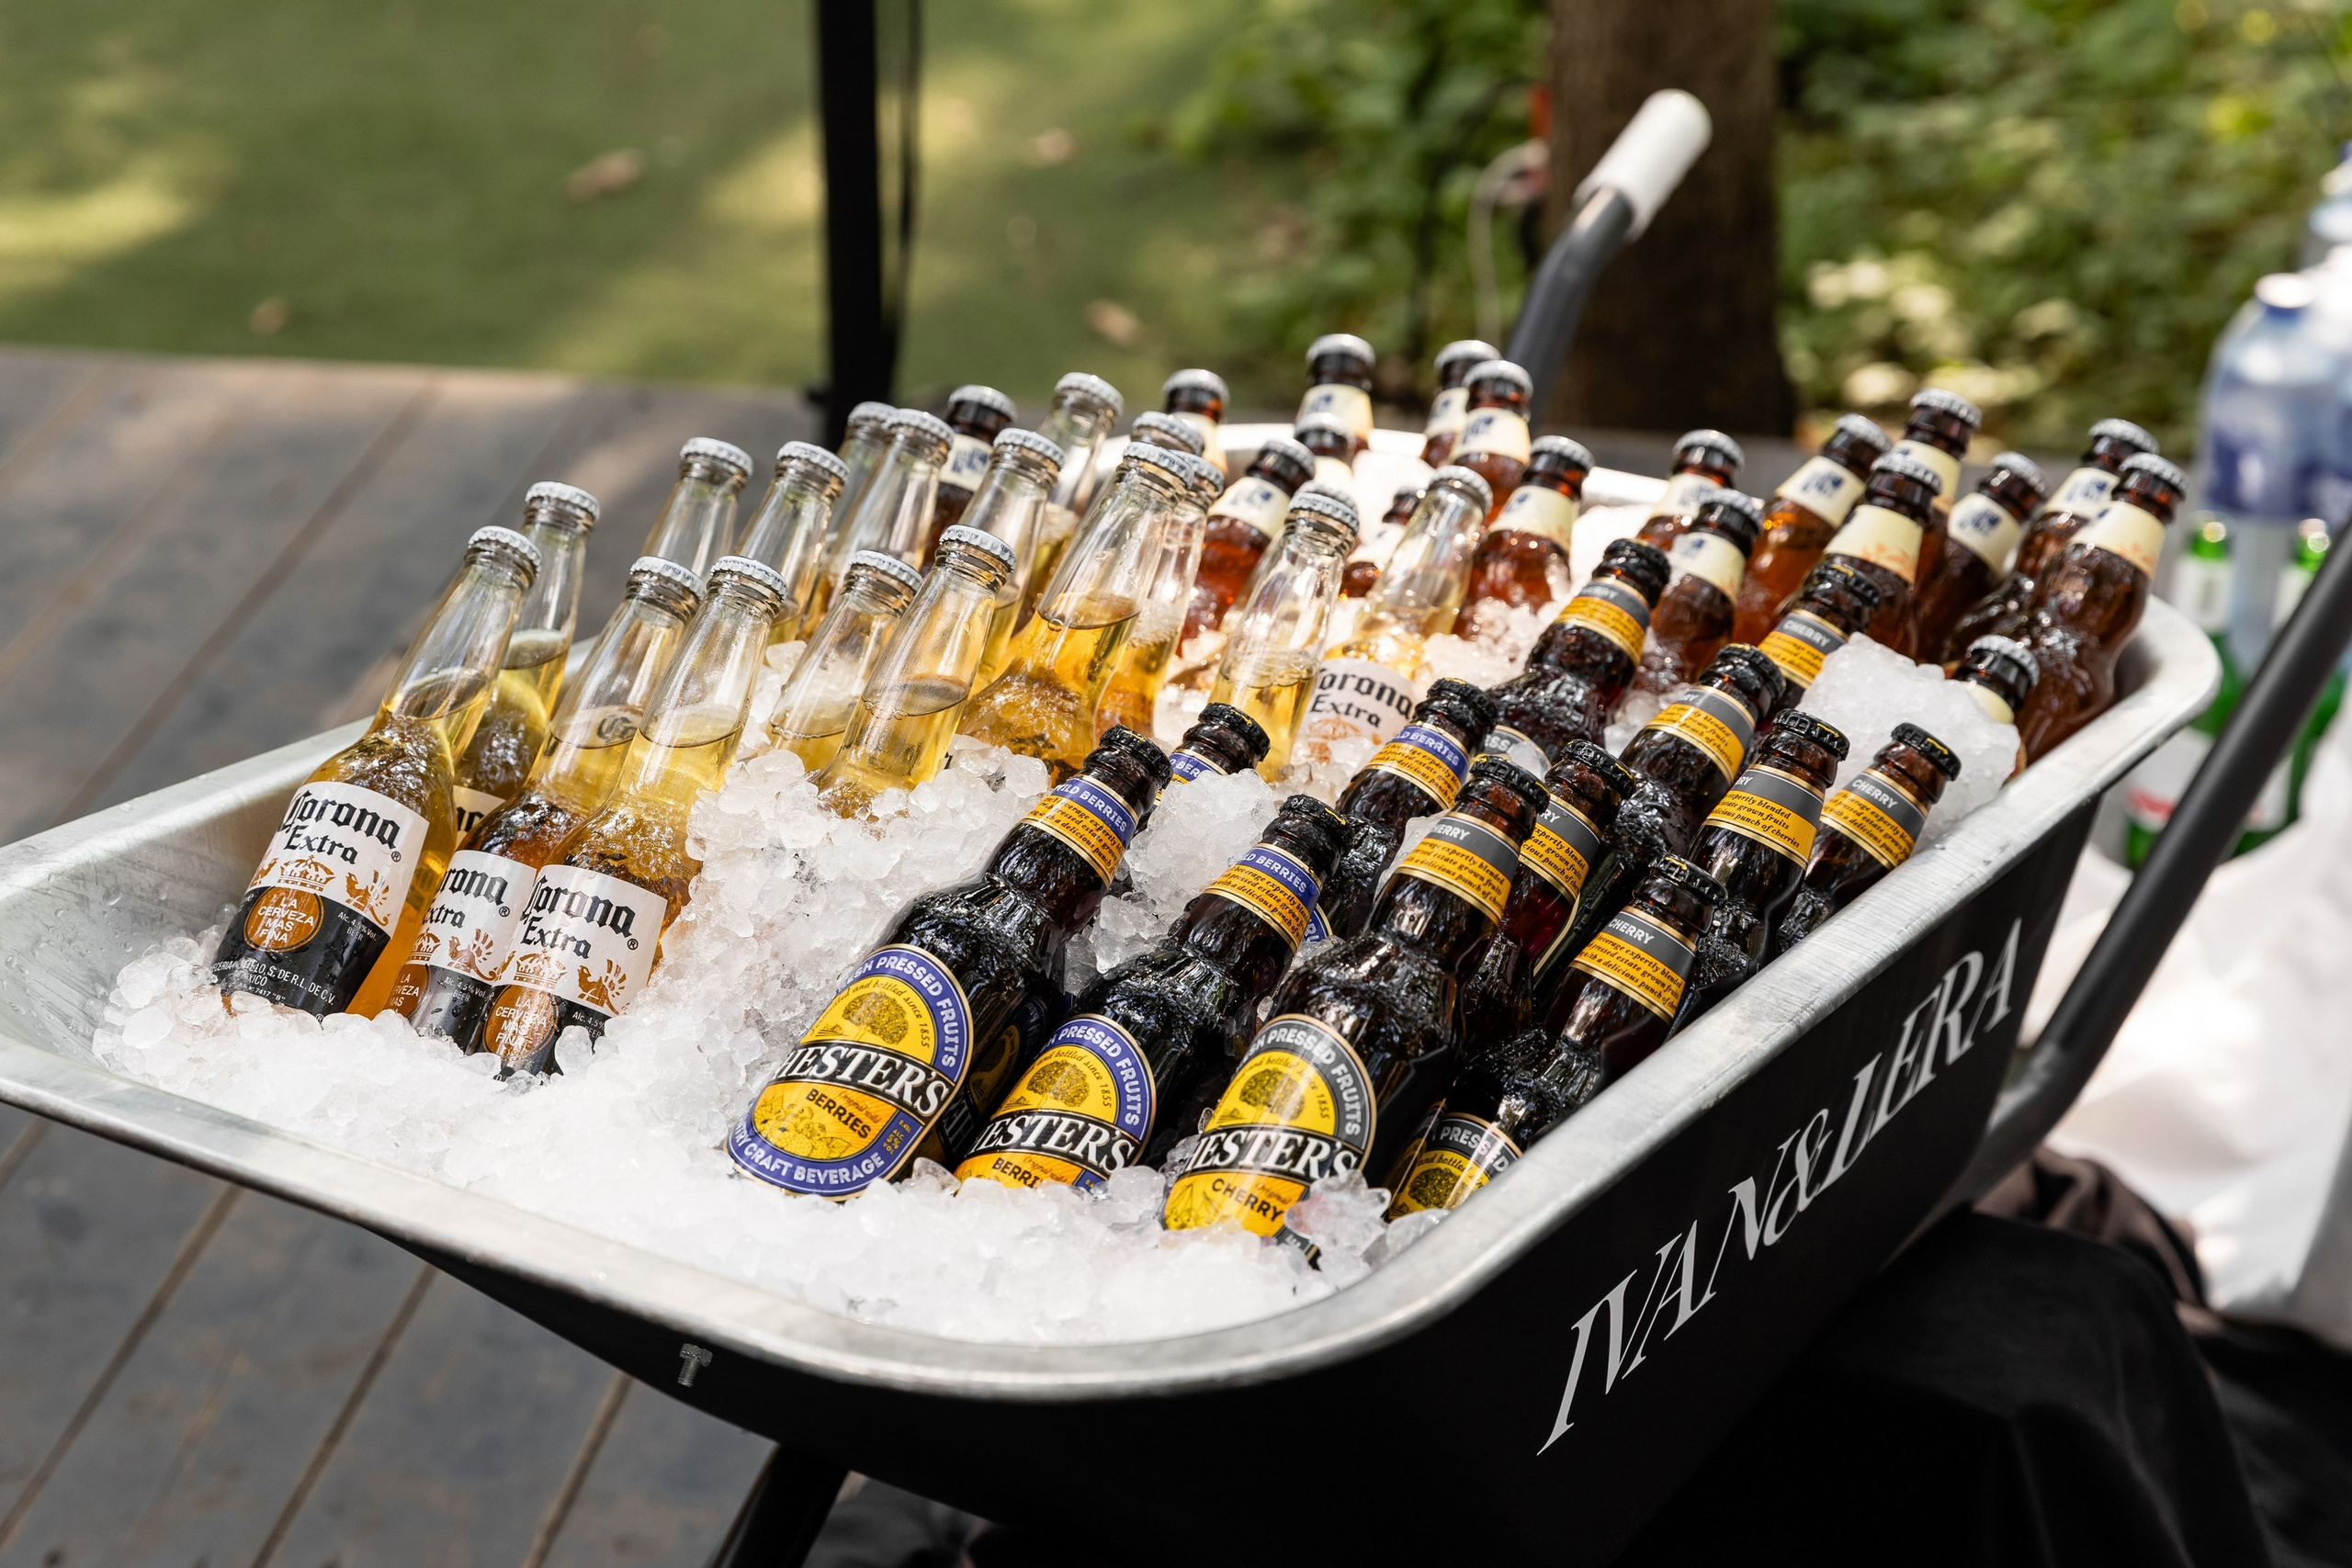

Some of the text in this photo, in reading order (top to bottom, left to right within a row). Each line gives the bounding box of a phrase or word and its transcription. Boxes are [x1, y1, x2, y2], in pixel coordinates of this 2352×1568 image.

[1310, 693, 1381, 728] Extra
[1318, 668, 1413, 721] orona
[1409, 732, 1460, 766] BERRIES
[1757, 799, 1792, 819] blended
[1852, 779, 1898, 809] CHERRY
[277, 790, 401, 850] Corona
[1079, 790, 1127, 832] BERRIES
[1736, 803, 1790, 830] grown fruits
[1861, 815, 1885, 833] estate
[1871, 810, 1899, 836] expertly
[283, 825, 358, 865] Extra
[1060, 822, 1095, 849] delicious
[1092, 846, 1112, 867] punch
[1081, 823, 1103, 843] estate
[1090, 818, 1117, 846] expertly
[1430, 824, 1471, 841] HERRY
[1735, 813, 1801, 848] punch of cherries
[1442, 845, 1505, 886] expertly blended
[1543, 856, 1573, 883] punch of
[1544, 847, 1570, 866] grown
[1255, 855, 1307, 894] BERRIES
[1432, 852, 1458, 865] estate
[1457, 863, 1486, 883] grown
[1485, 878, 1503, 896] fruits
[1454, 874, 1482, 893] punch
[1481, 890, 1491, 899] of
[280, 897, 298, 909] LA
[520, 874, 636, 939] Corona
[1237, 884, 1273, 909] delicious
[1271, 906, 1292, 927] punch
[1290, 925, 1298, 935] of
[1258, 884, 1282, 904] estate
[1279, 901, 1301, 923] grown
[1266, 881, 1297, 907] expertly
[257, 906, 314, 927] CERVEZA
[265, 918, 295, 931] MAS
[337, 911, 350, 923] Alc.
[367, 928, 377, 942] Vol.
[1609, 919, 1655, 944] CHERRY
[259, 928, 288, 943] FINA
[346, 926, 364, 942] BEER
[521, 915, 593, 960] Extra
[444, 976, 456, 987] Alc.
[1602, 958, 1640, 984] delicious
[1638, 980, 1663, 999] punch
[1661, 996, 1669, 1006] of
[1616, 954, 1642, 972] estate
[1640, 969, 1667, 990] grown
[1625, 949, 1661, 973] expertly
[1660, 968, 1683, 989] blended
[254, 987, 271, 997] 7417
[277, 968, 289, 982] DE
[290, 975, 307, 990] R.L.
[308, 981, 322, 997] DE
[321, 987, 336, 1006] C.V.
[452, 989, 471, 1003] BEER
[495, 1006, 548, 1028] CERVEZA
[515, 997, 531, 1010] LA
[572, 1011, 586, 1023] Alc.
[853, 980, 930, 1049] and bottled since 1855
[876, 955, 959, 1068] PRESSED FRUITS
[501, 1020, 528, 1036] MAS
[1056, 1049, 1087, 1062] bottled
[1084, 1060, 1102, 1081] since
[1100, 1083, 1112, 1108] 1855
[1058, 1025, 1142, 1126] PRESSED FRUITS
[1268, 1028, 1362, 1136] PRESSED FRUITS
[806, 1088, 872, 1139] BERRIES
[1317, 1093, 1329, 1120] 1855
[744, 1143, 886, 1185] CRAFT BEVERAGE
[883, 1143, 895, 1156] VOL
[1419, 1154, 1435, 1166] and
[1440, 1126, 1510, 1173] PRESSED
[992, 1156, 1040, 1189] BERRI
[1211, 1179, 1284, 1223] CHERRY
